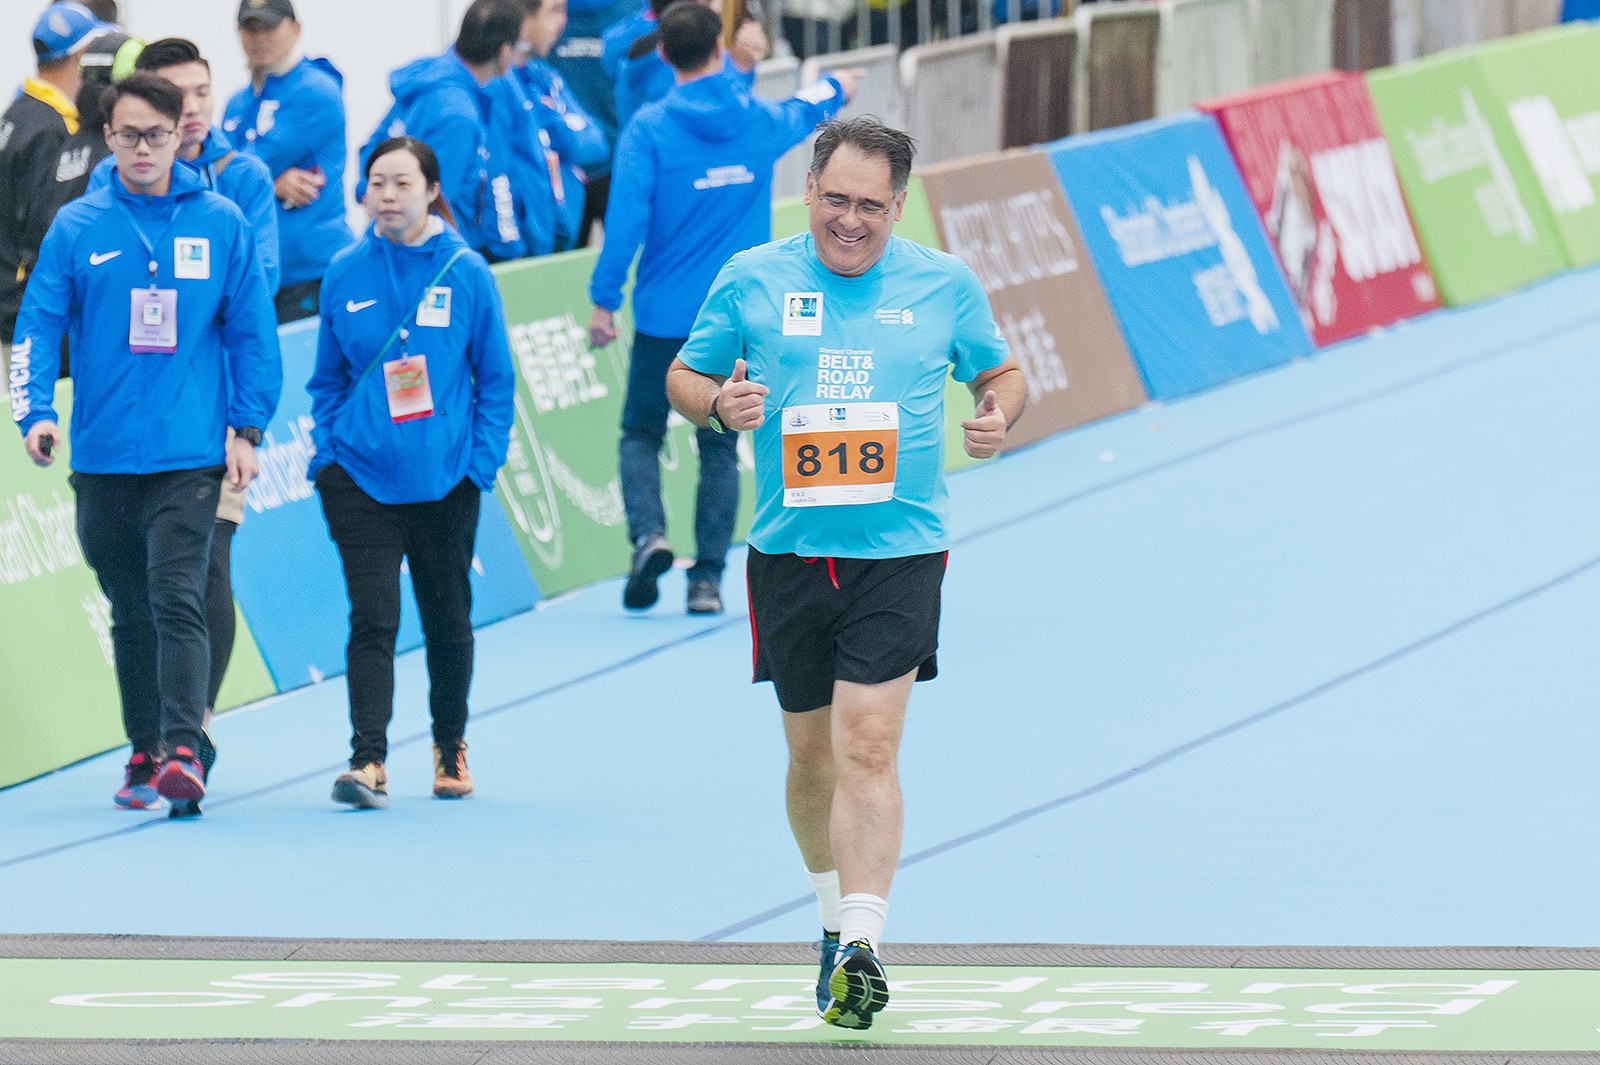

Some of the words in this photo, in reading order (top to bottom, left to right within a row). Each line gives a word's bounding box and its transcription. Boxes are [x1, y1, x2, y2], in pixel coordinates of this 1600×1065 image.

[818, 354, 874, 370] BELT&
[9, 336, 32, 422] OFFICIAL
[817, 369, 870, 385] ROAD
[816, 384, 874, 399] RELAY
[796, 441, 885, 477] 818
[206, 971, 1520, 996] Standard
[47, 991, 1486, 1016] Chartered
[346, 1012, 1438, 1037] 渣打銀行
